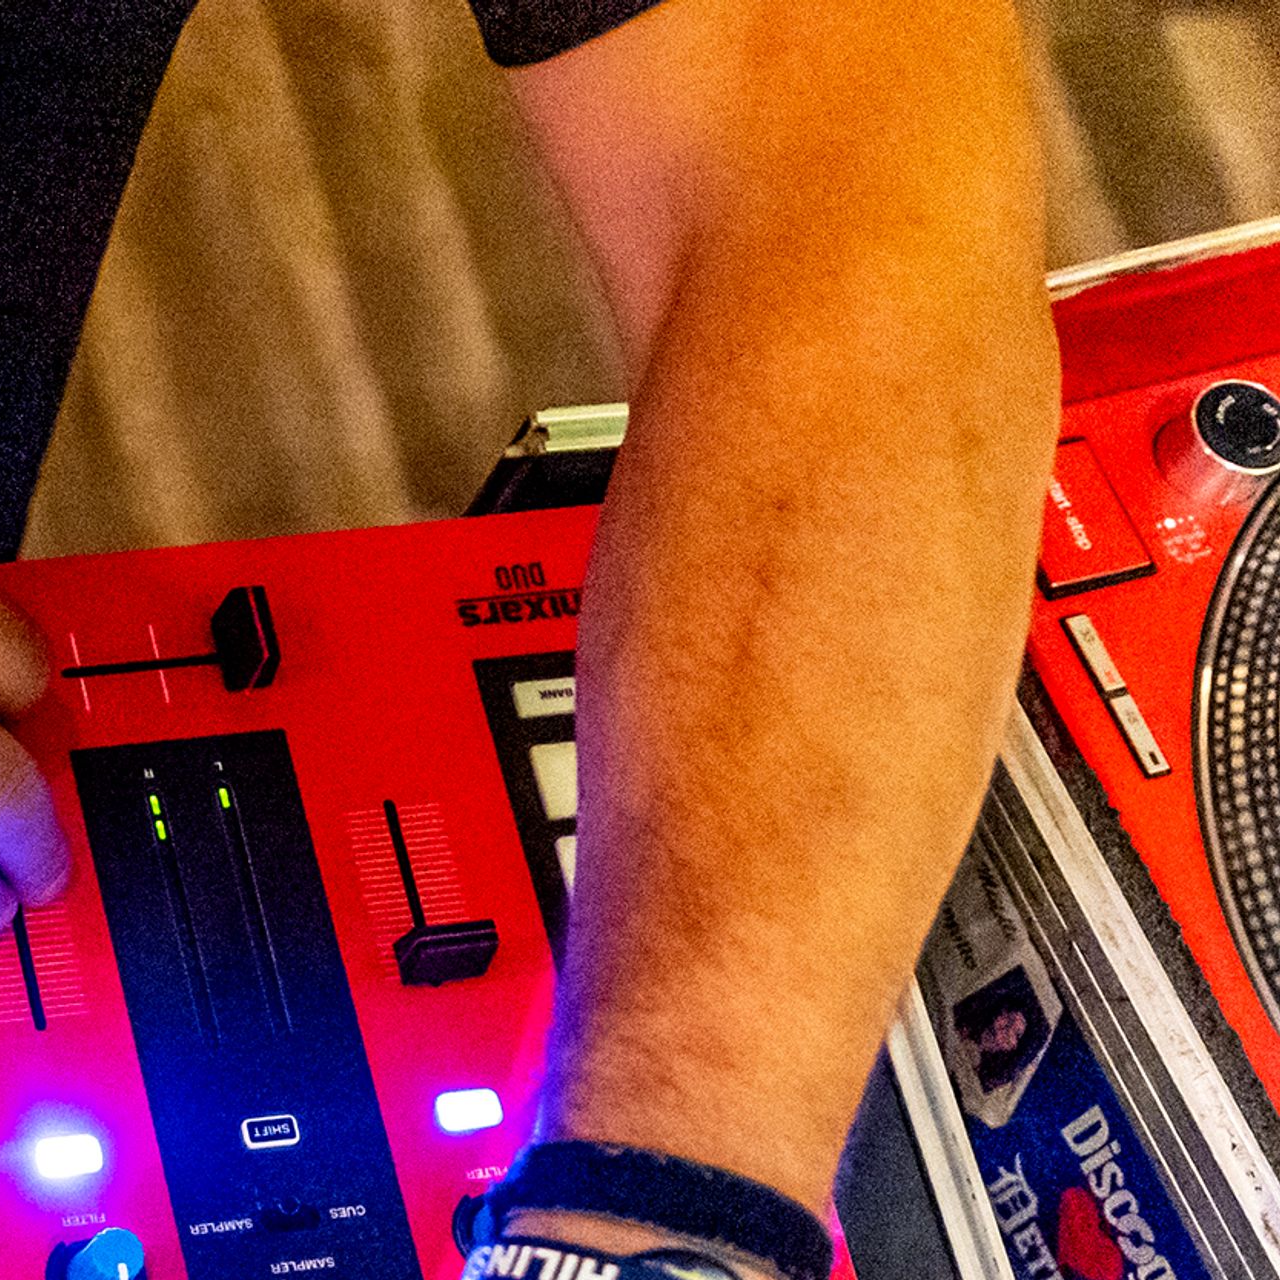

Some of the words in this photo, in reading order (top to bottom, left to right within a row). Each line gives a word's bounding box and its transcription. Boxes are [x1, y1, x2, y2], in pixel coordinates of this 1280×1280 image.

[493, 561, 547, 591] DUO
[538, 686, 574, 700] BANK
[253, 1123, 291, 1138] SHIFT
[61, 1212, 106, 1228] FILTER
[328, 1204, 367, 1220] CUES
[189, 1217, 254, 1236] SAMPLER
[270, 1256, 335, 1275] SAMPLER
